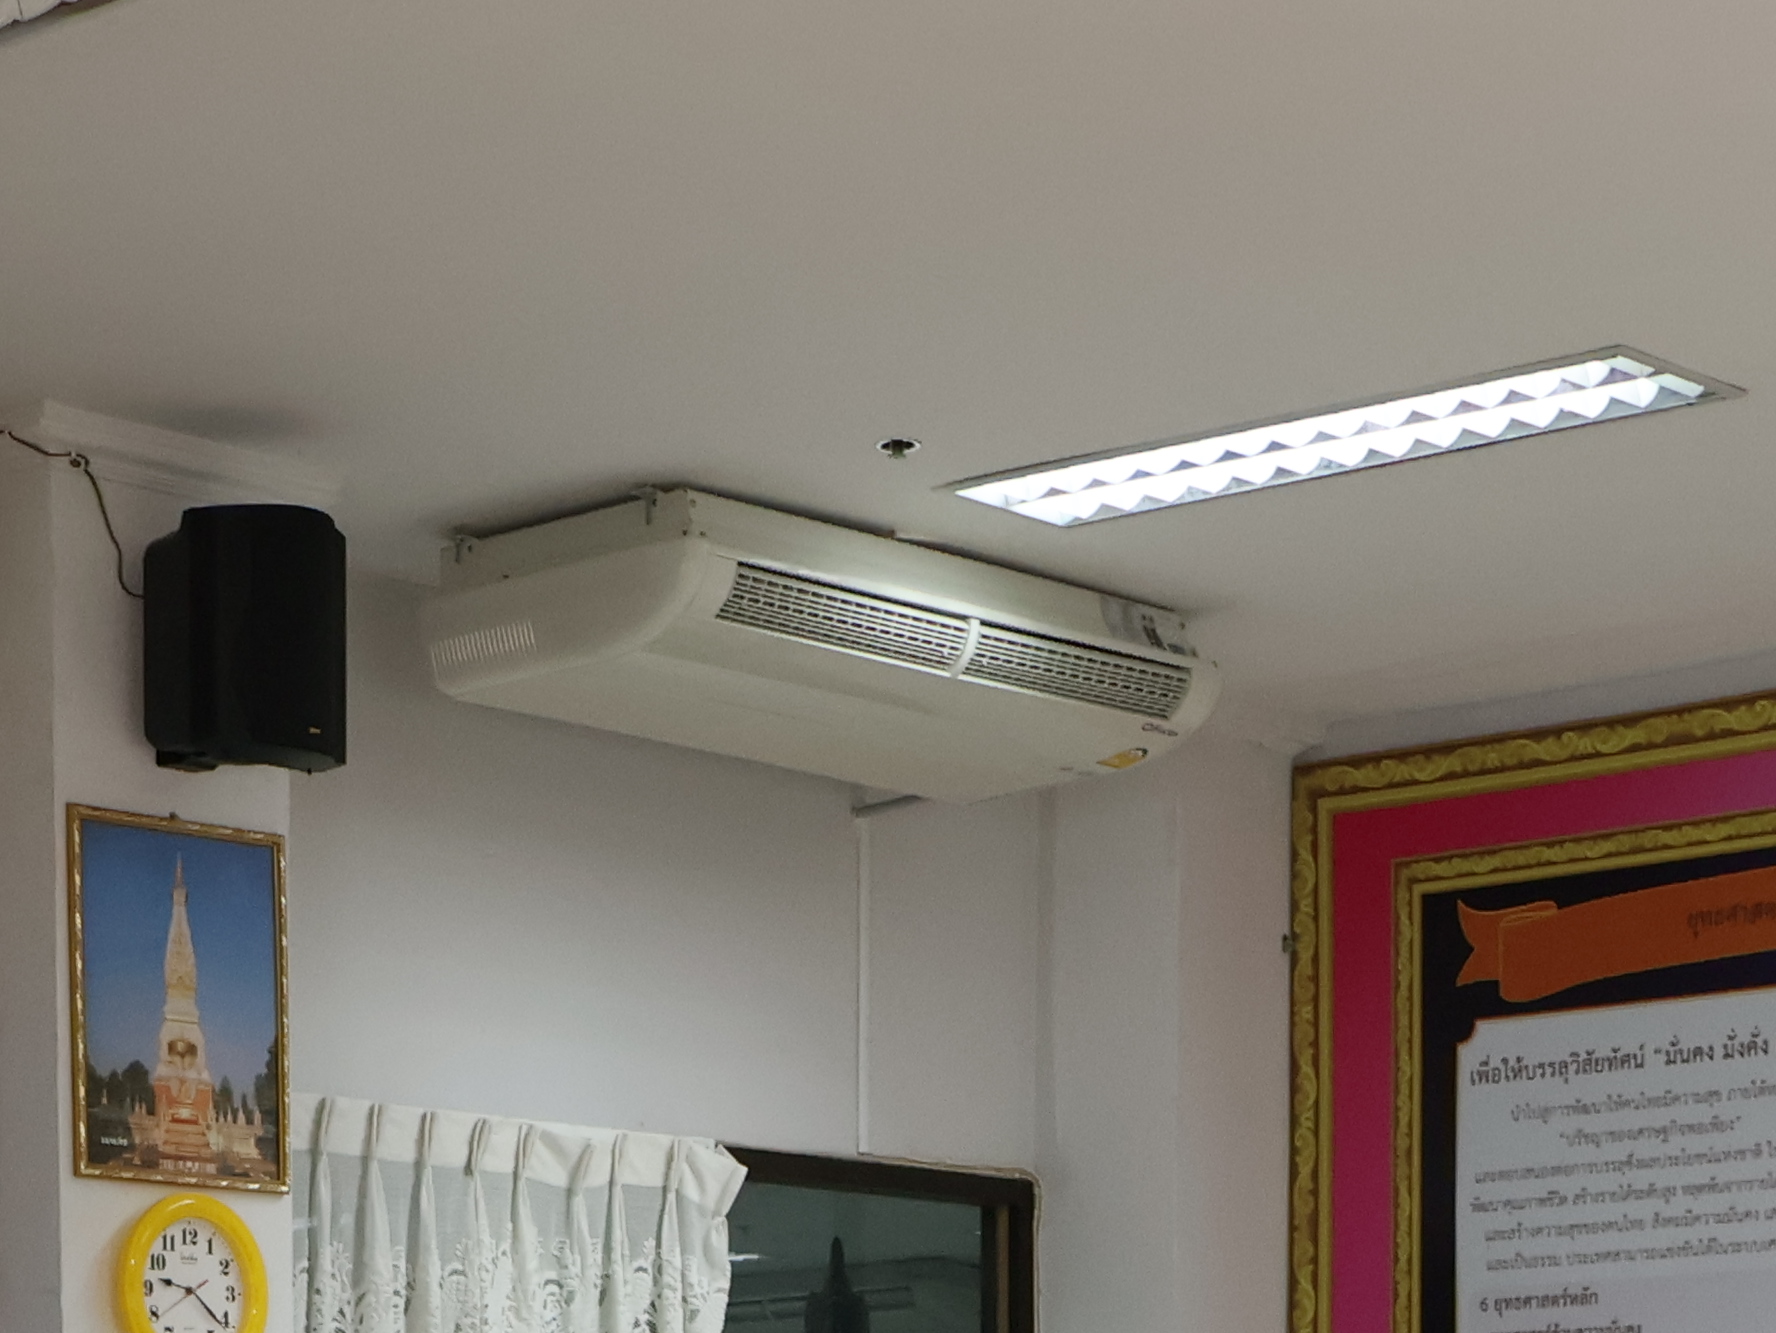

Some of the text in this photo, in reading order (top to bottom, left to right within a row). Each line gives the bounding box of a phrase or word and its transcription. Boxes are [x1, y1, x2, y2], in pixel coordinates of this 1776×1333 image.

[1722, 1025, 1770, 1063] มั่งคั่ง
[162, 1234, 176, 1252] 11
[181, 1227, 198, 1246] 12
[206, 1237, 214, 1255] 1
[148, 1253, 166, 1271] 10
[219, 1258, 230, 1276] 2
[144, 1279, 154, 1297] 9
[225, 1285, 236, 1303] 3
[1480, 1295, 1489, 1313] 6
[149, 1305, 160, 1323] 8
